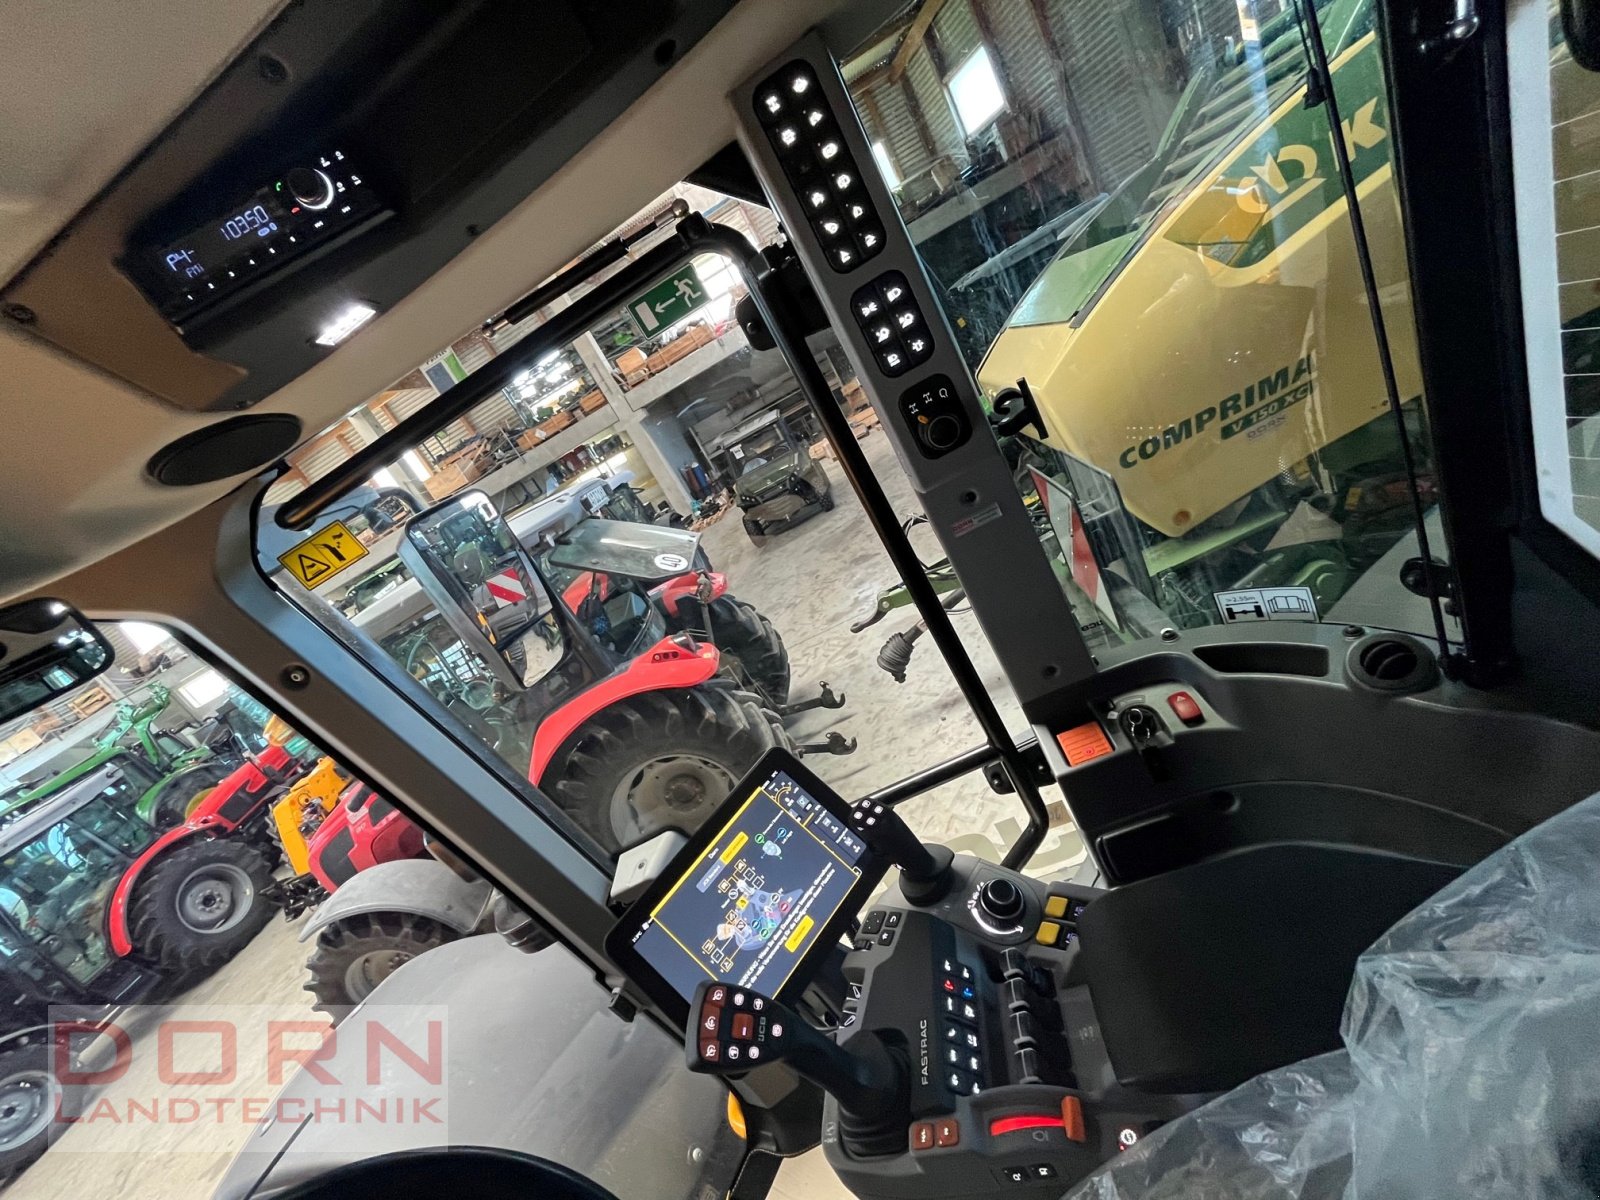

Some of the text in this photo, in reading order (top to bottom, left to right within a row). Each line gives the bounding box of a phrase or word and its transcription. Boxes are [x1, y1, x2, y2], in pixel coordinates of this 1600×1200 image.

[1119, 354, 1314, 469] COMPRIMA
[1231, 421, 1244, 433] V
[1245, 401, 1278, 425] 150
[920, 1019, 929, 1086] FASTRAC
